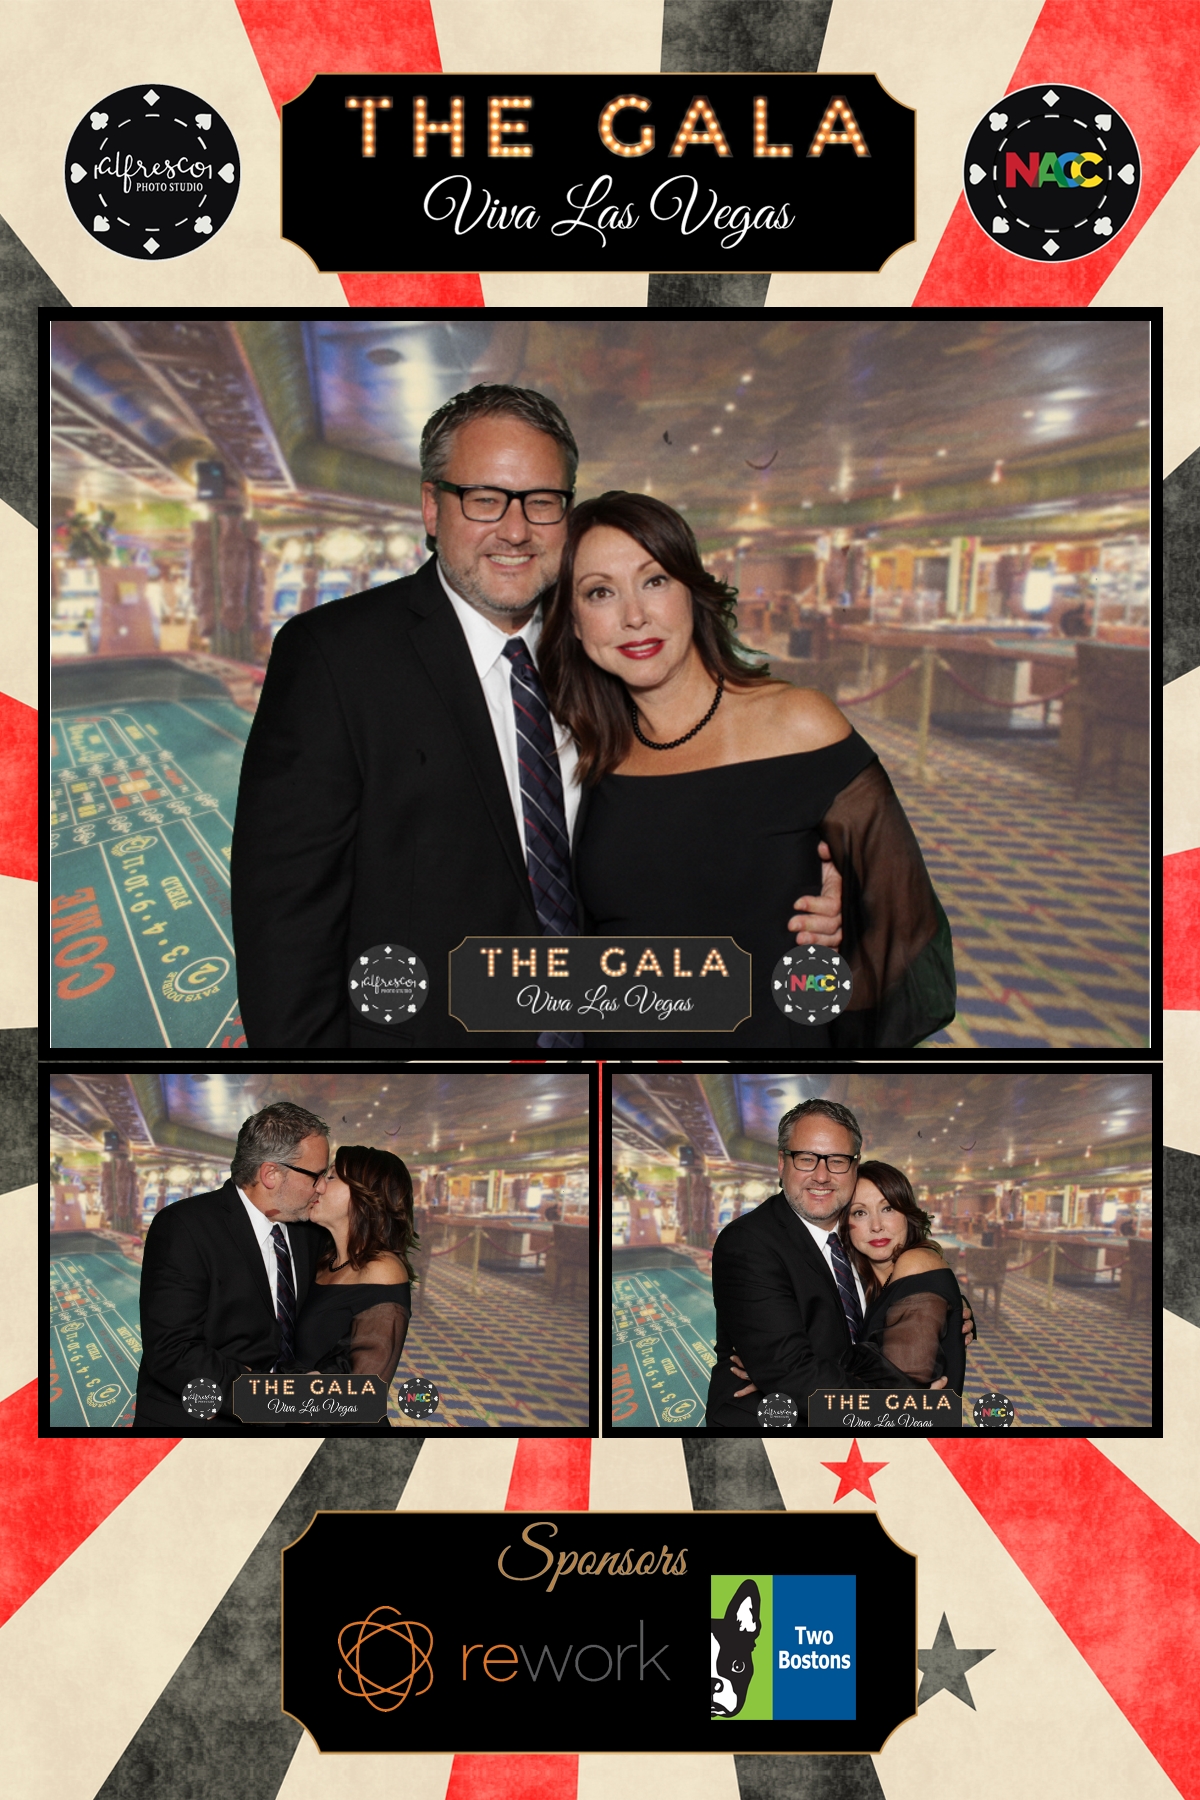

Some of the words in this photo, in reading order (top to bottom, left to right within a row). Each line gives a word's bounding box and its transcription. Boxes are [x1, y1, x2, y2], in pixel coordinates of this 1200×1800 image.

[124, 874, 149, 893] 10
[161, 876, 193, 911] FIELD
[130, 899, 157, 913] 9
[142, 921, 168, 935] 4
[51, 886, 116, 1000] COME
[161, 945, 190, 964] 3
[187, 962, 220, 985] 2
